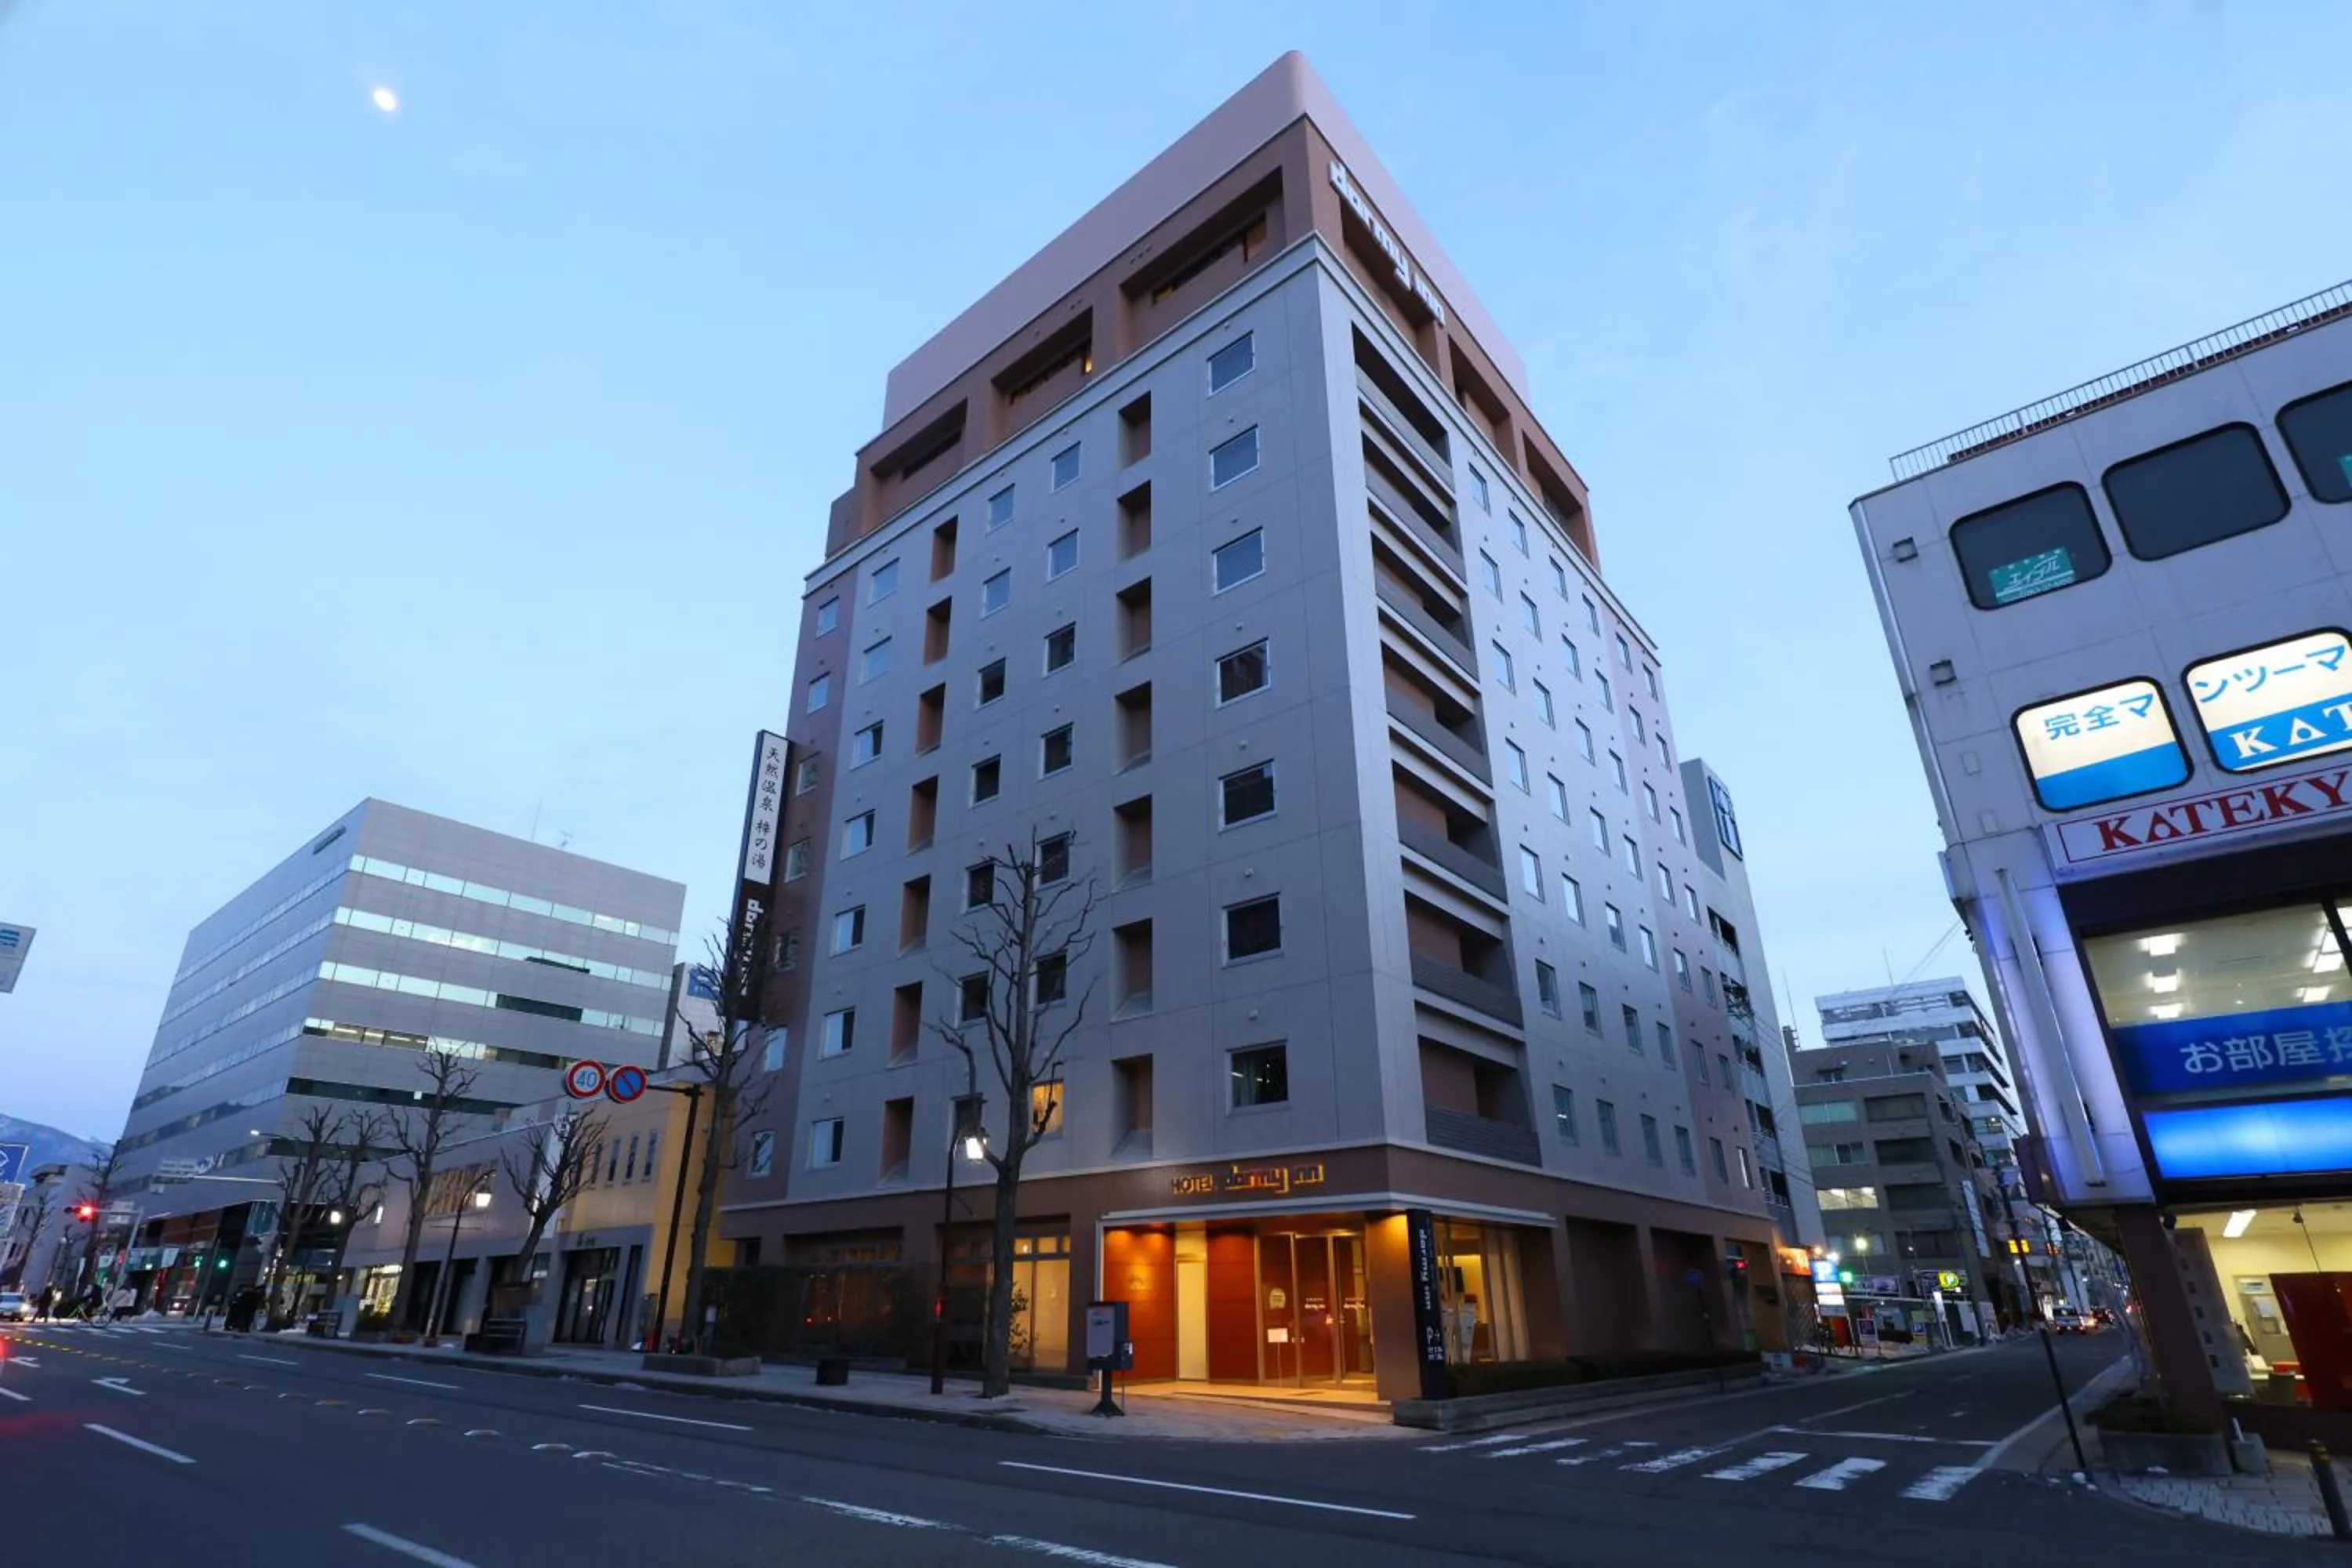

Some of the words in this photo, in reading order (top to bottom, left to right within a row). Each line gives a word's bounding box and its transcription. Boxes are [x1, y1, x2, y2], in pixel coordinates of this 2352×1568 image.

[2044, 693, 2154, 741] 完全マ
[2094, 770, 2350, 852] KATEKY
[576, 1071, 597, 1087] 40
[1171, 1174, 1213, 1195] HOTEL
